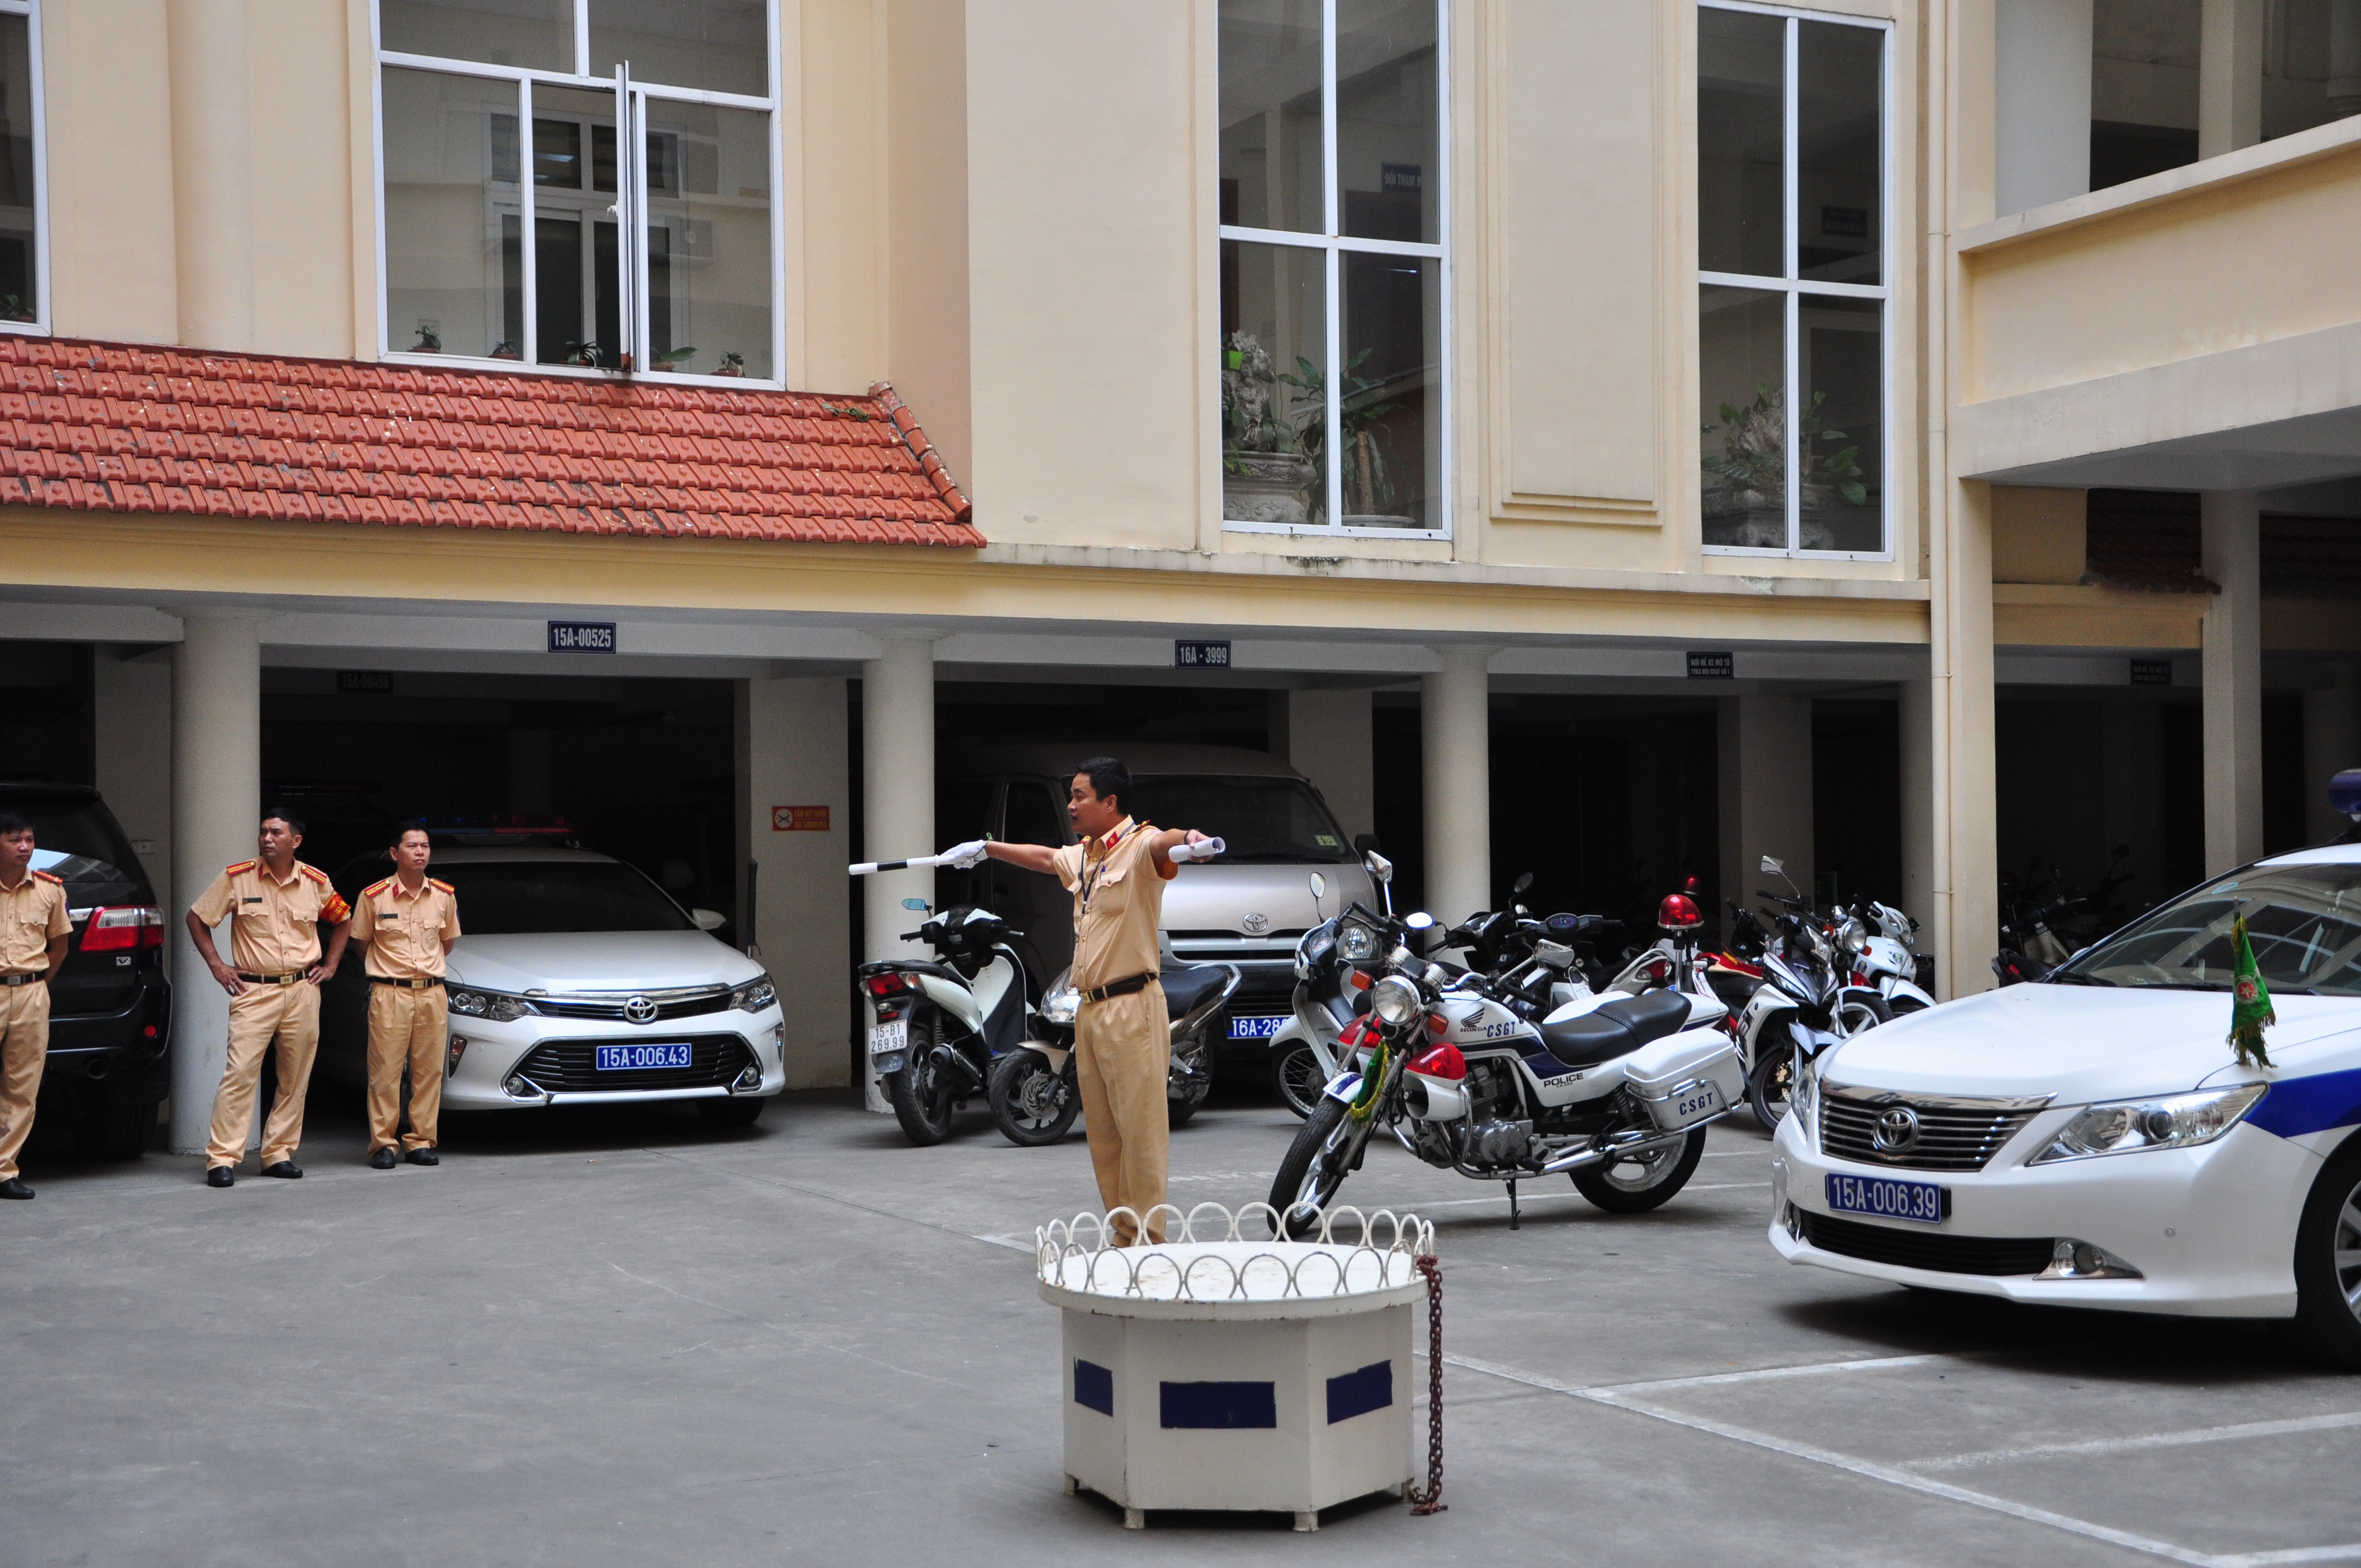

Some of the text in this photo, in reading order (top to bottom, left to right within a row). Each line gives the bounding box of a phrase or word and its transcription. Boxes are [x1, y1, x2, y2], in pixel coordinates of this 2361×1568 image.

[553, 628, 611, 647] 15A-00525
[1180, 646, 1197, 663] 16A
[1205, 646, 1227, 664] 3999
[875, 1023, 900, 1039] 15-B1
[1487, 1021, 1515, 1037] CSGT
[871, 1035, 904, 1052] 269.99
[602, 1046, 688, 1067] 15A-006.43
[1543, 1072, 1584, 1087] POLICE
[1679, 1092, 1712, 1115] CSGT
[1834, 1177, 1936, 1218] 15A-006.39
